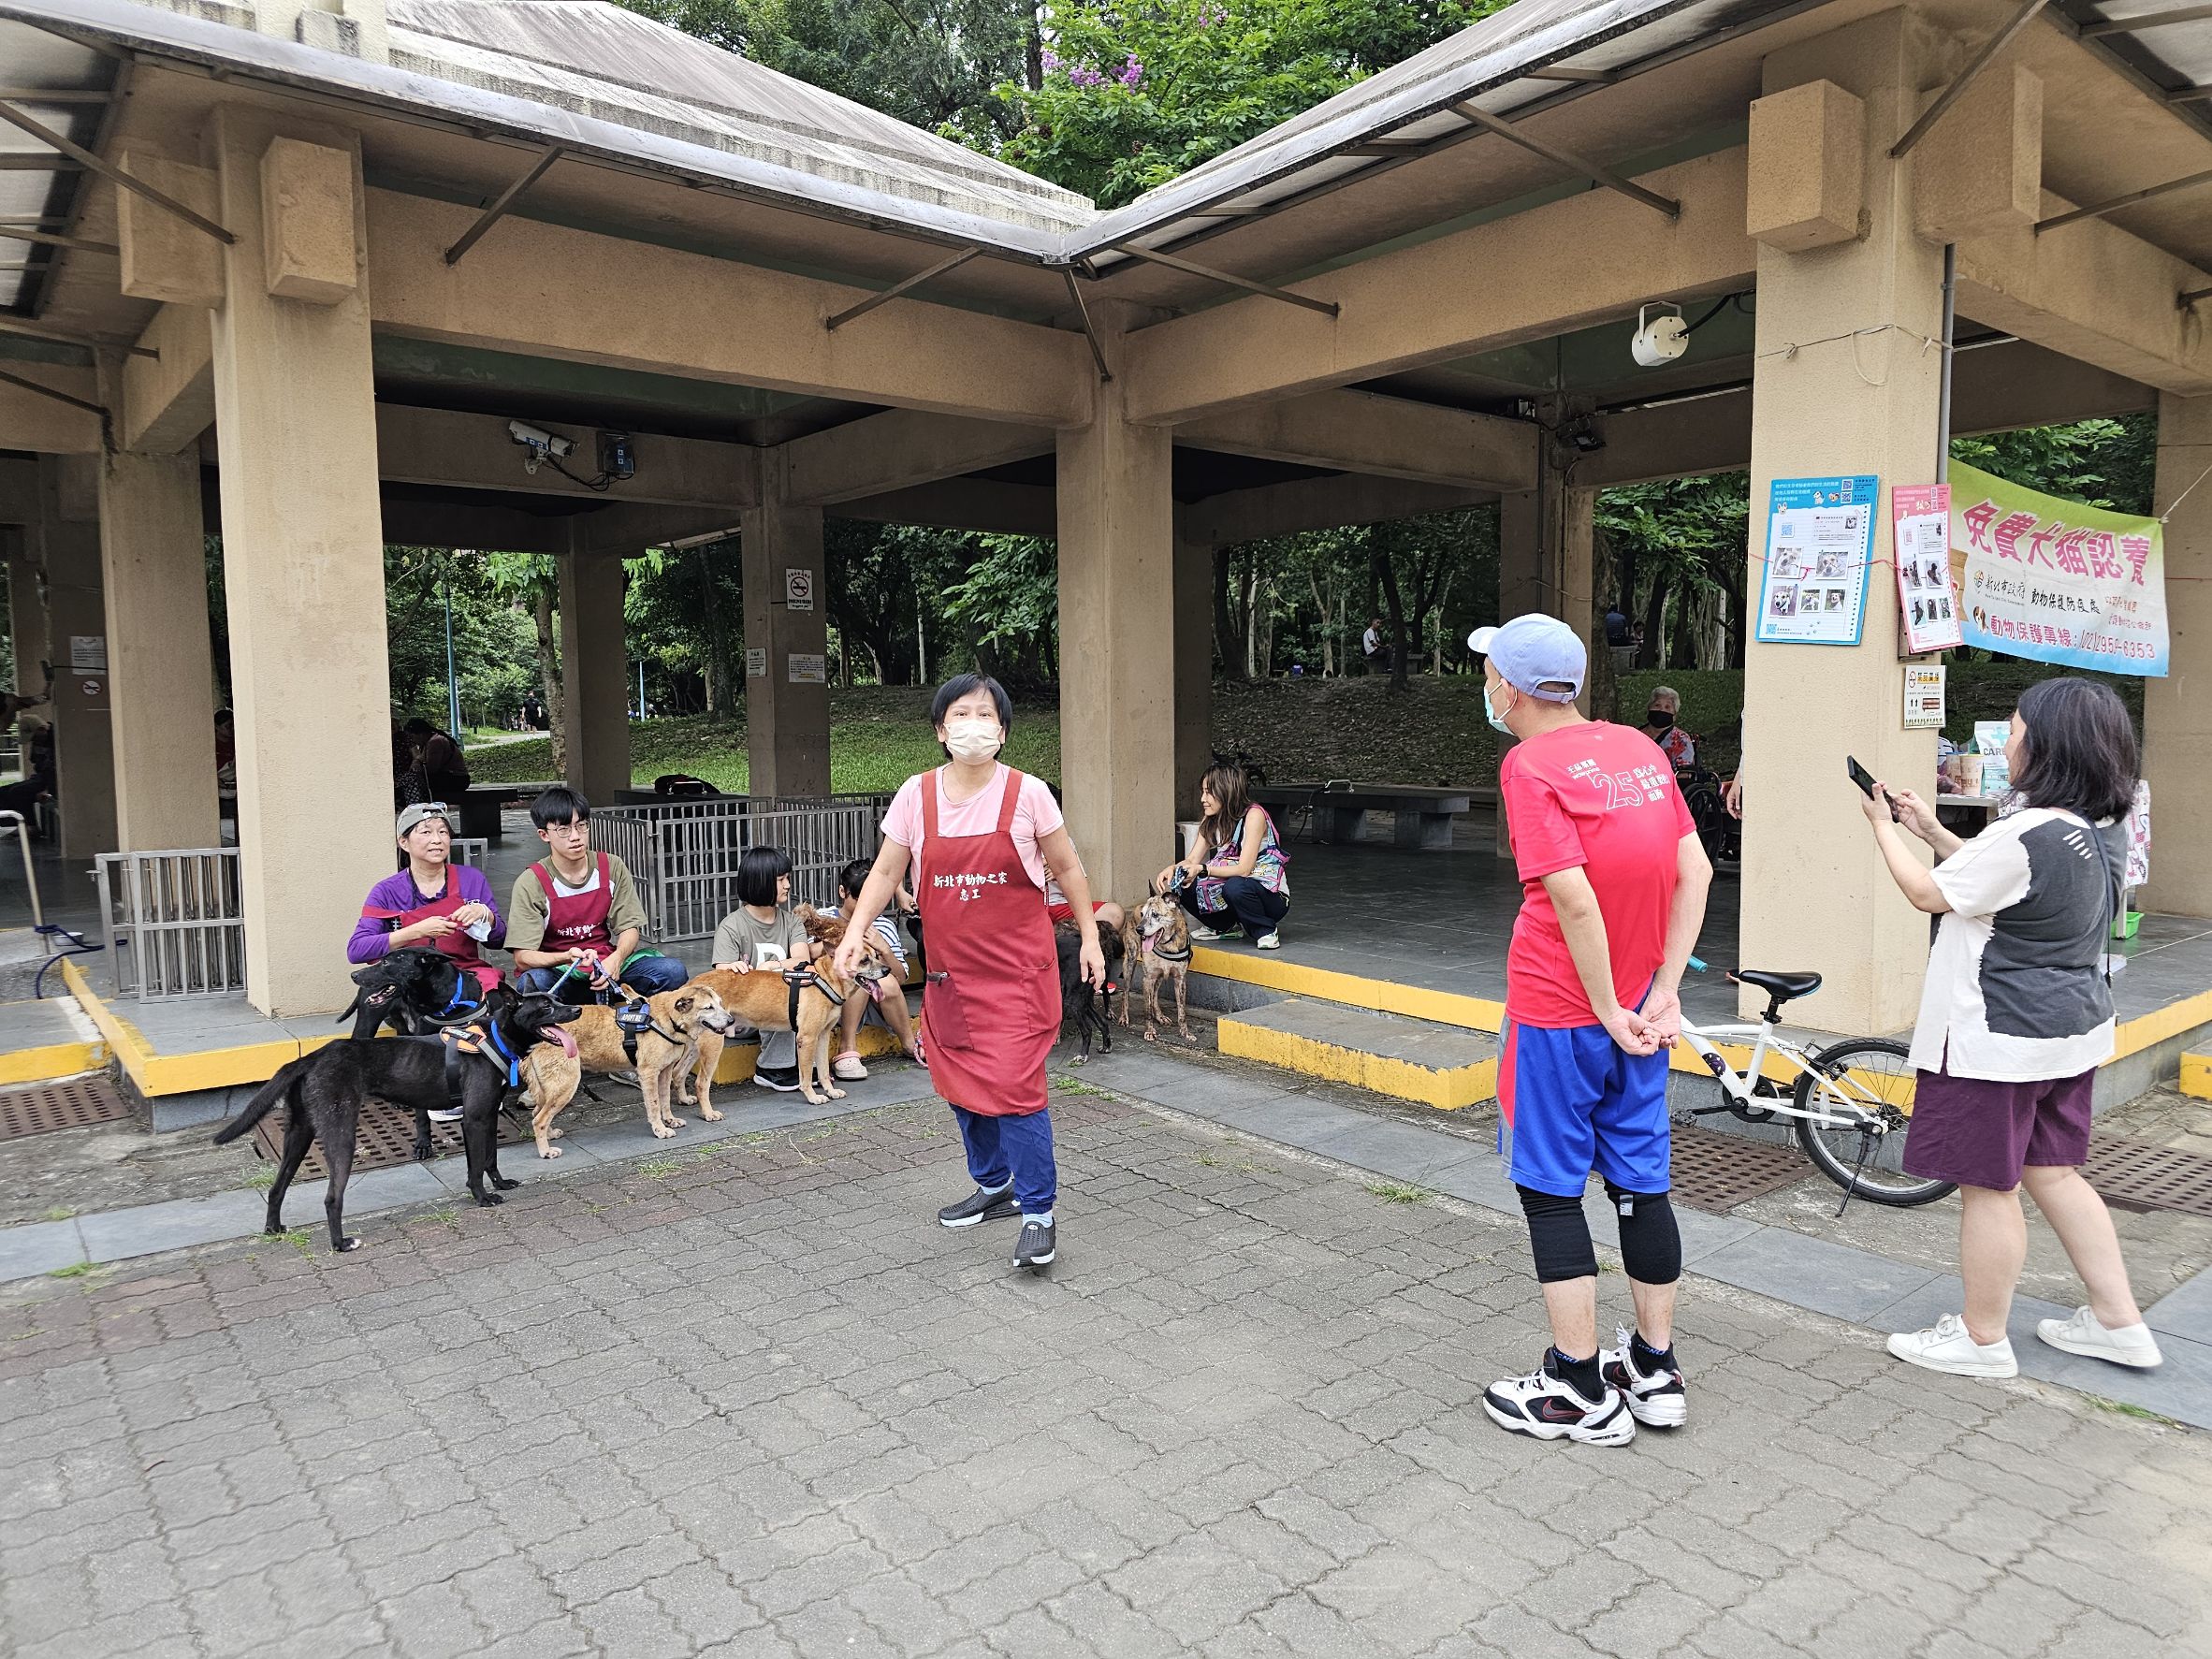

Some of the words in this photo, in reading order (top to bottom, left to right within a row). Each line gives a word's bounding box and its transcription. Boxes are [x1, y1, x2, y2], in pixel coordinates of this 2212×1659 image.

[1963, 502, 2151, 587] 免費犬貓認養
[1985, 574, 2026, 600] 新北市政府
[933, 870, 1008, 888] 新北市動物之家
